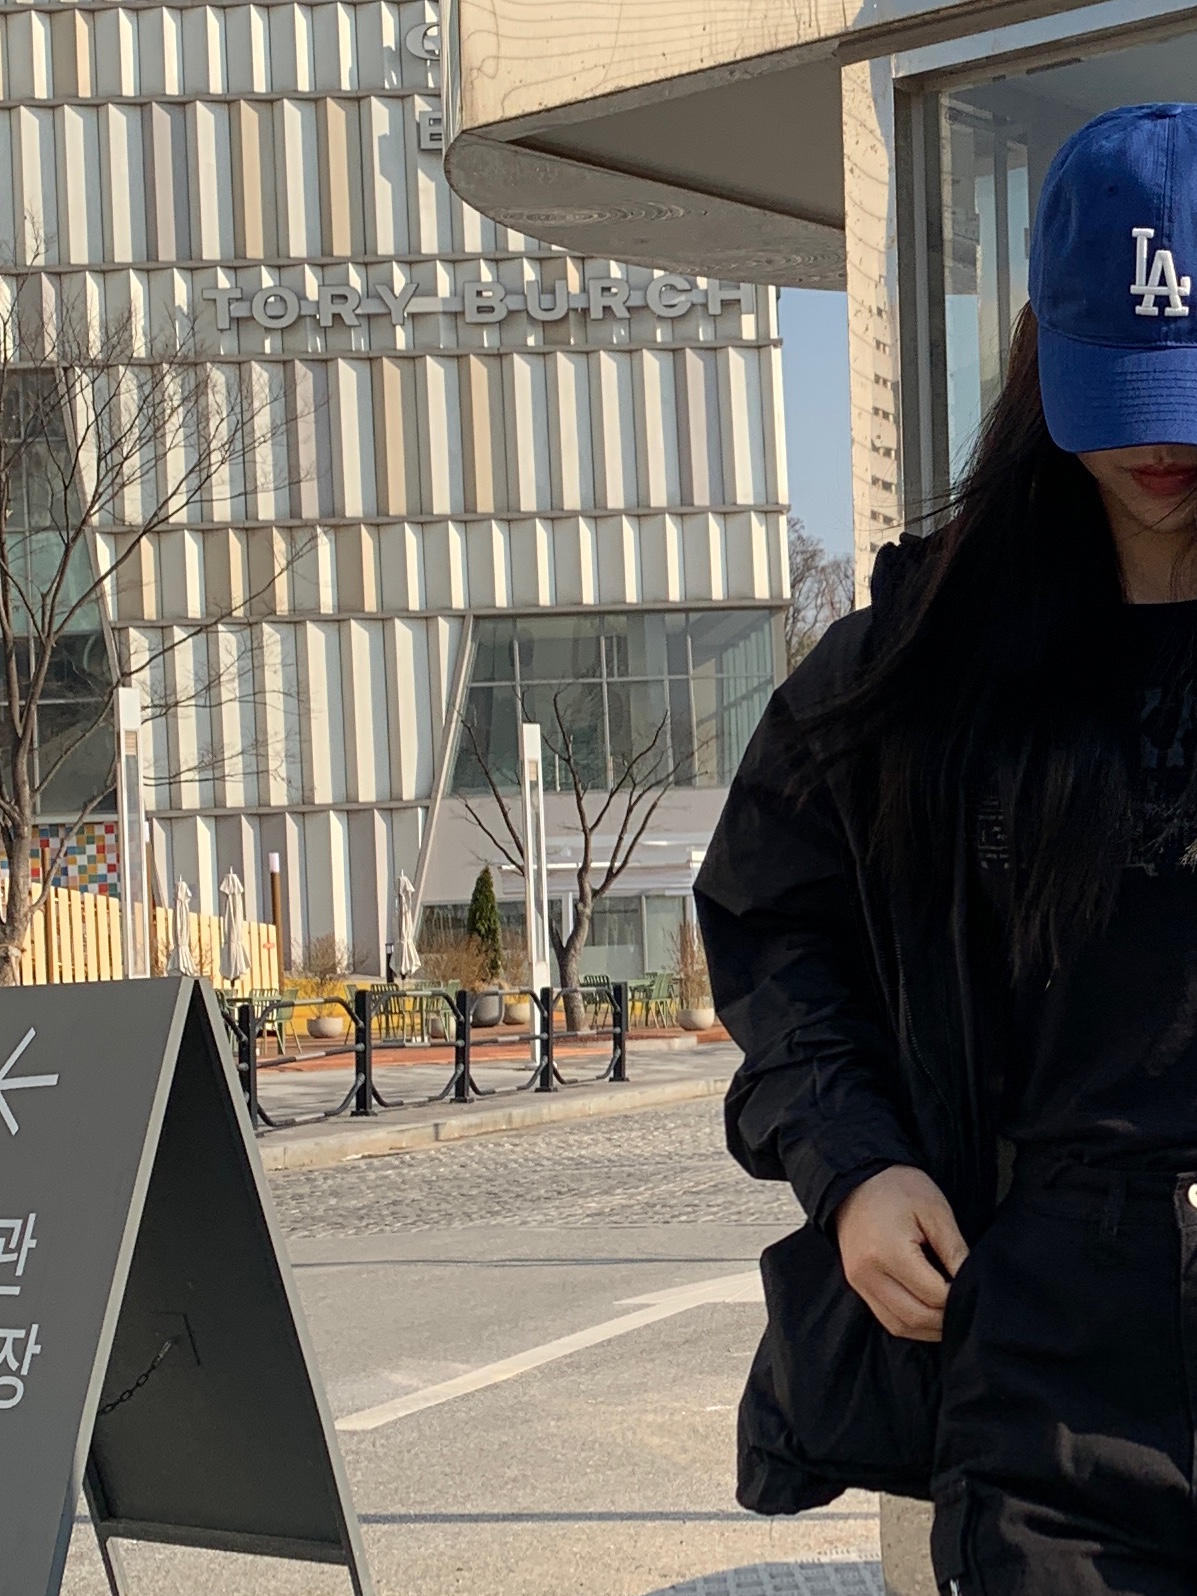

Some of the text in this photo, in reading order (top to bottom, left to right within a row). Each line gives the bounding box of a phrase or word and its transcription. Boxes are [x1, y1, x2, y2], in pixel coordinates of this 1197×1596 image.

[202, 274, 756, 330] TORY BURCH
[1130, 227, 1191, 317] LA
